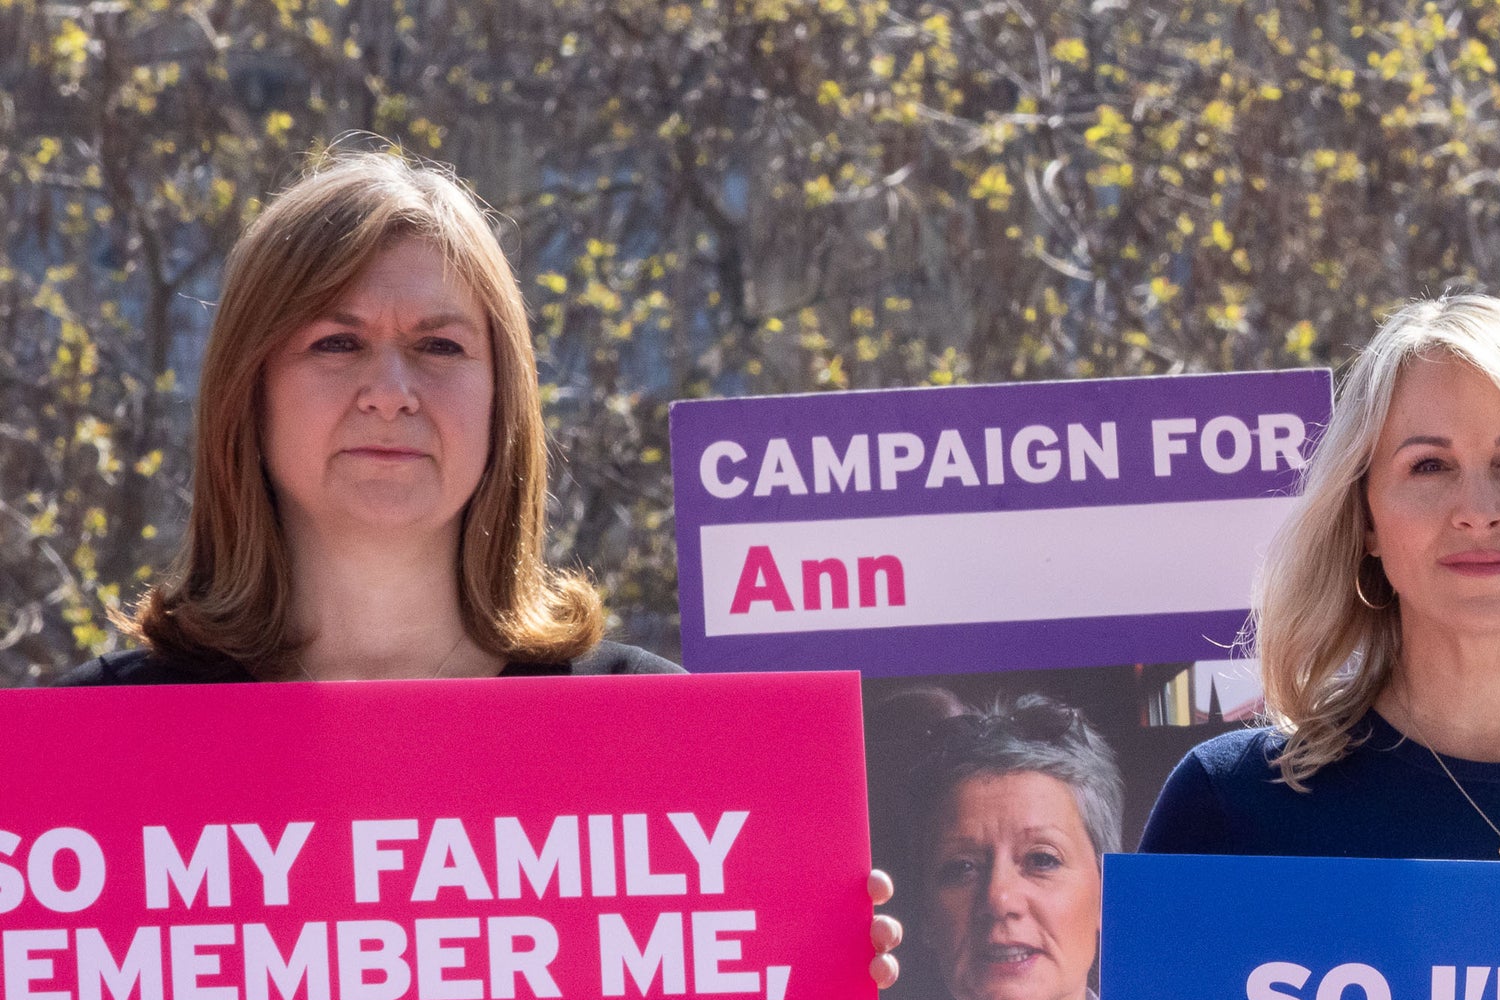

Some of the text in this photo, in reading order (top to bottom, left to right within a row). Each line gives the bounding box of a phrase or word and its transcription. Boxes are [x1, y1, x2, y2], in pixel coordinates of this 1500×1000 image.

[699, 413, 1306, 499] CAMPAIGN FOR
[729, 545, 907, 614] Ann
[143, 821, 315, 911] MY
[352, 810, 751, 904] FAMILY
